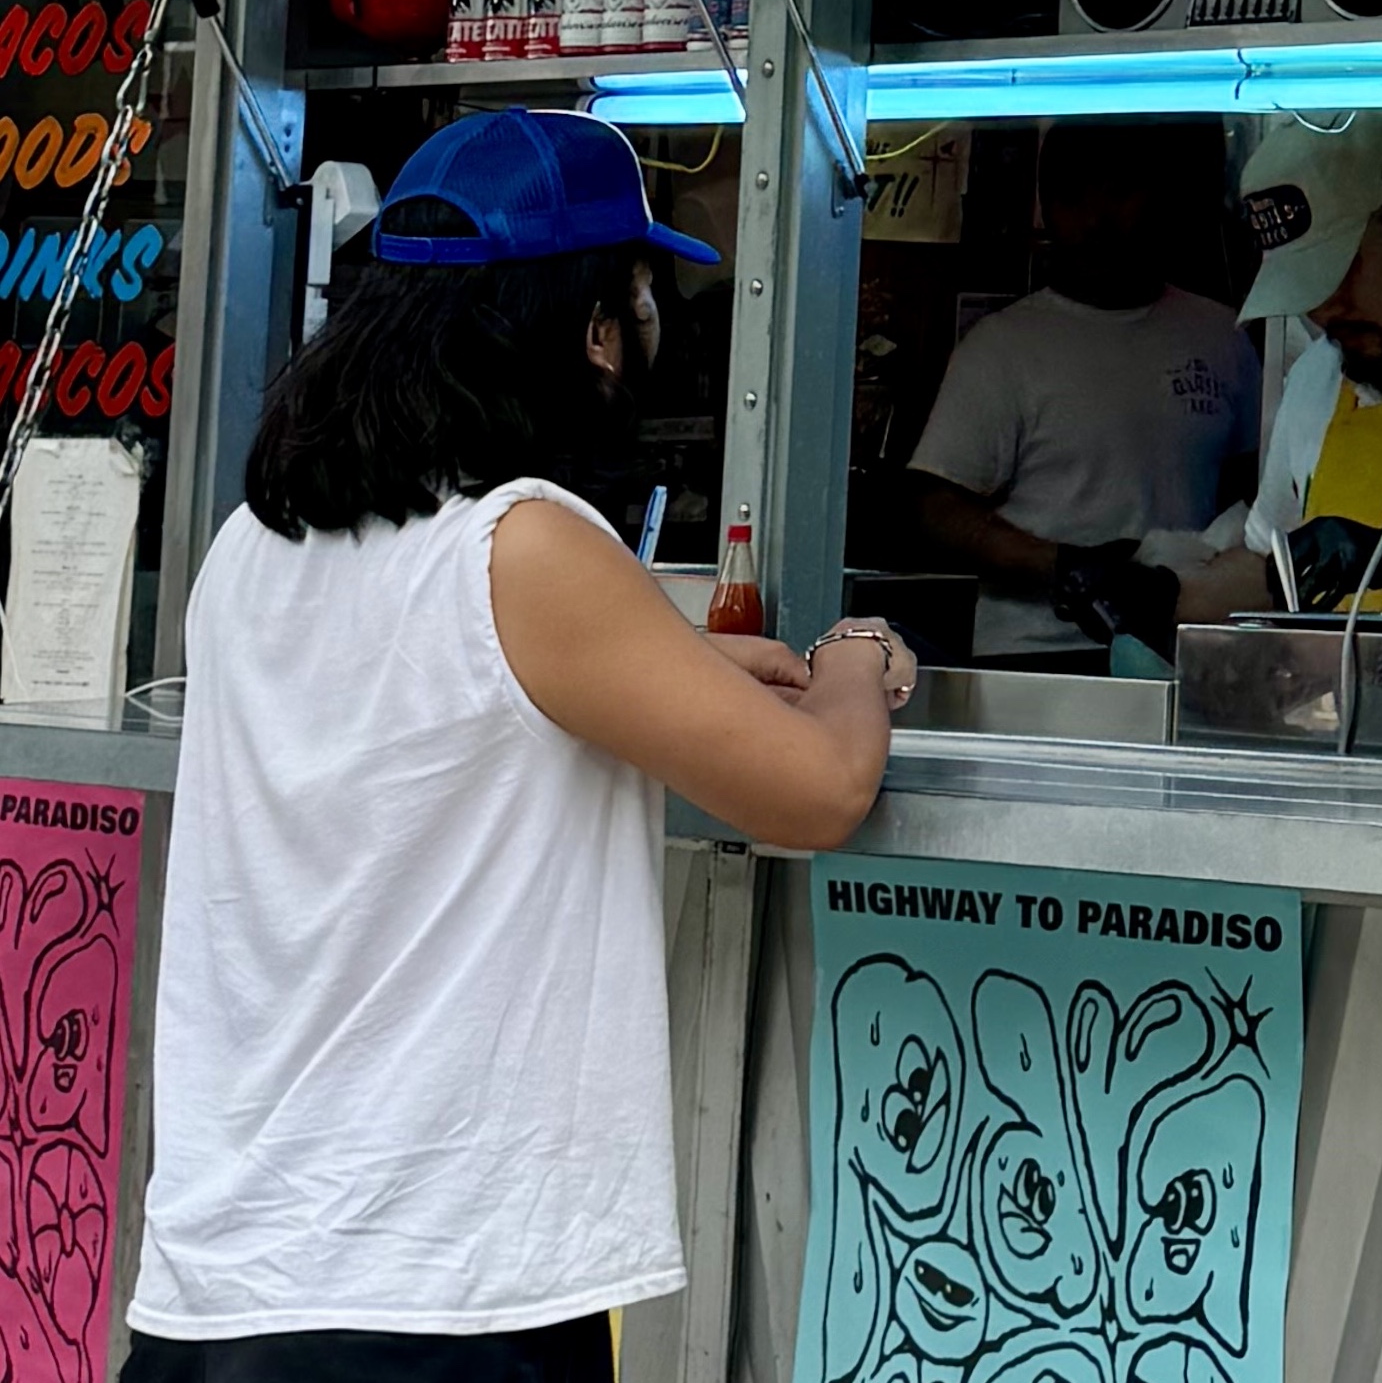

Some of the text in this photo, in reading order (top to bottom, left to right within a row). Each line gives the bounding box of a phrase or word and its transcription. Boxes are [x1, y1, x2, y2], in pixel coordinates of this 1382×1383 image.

[0, 794, 139, 836] PARADISO
[827, 879, 1283, 952] HIGHWAY TO PARADISO
